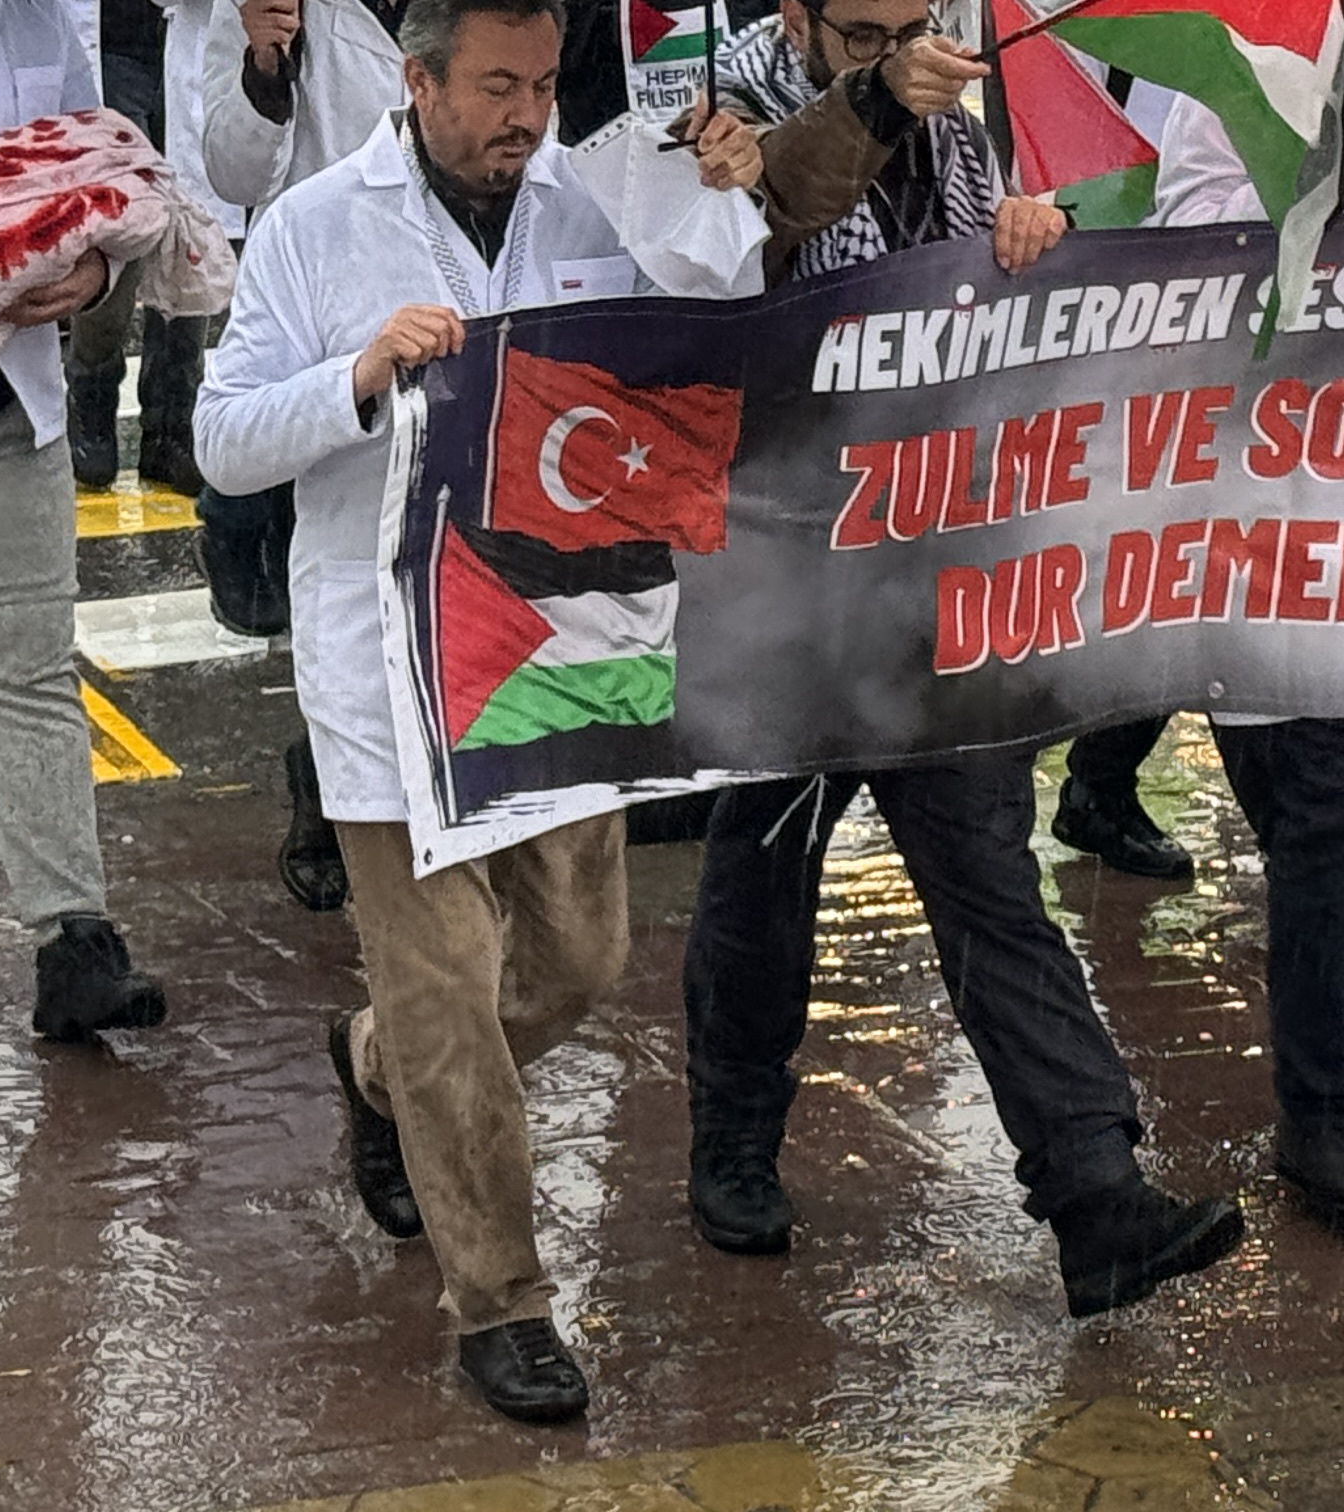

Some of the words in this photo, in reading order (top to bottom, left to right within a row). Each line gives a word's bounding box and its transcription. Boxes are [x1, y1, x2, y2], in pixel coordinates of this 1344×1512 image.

[646, 64, 705, 86] HEPİM
[812, 273, 1244, 393] HEKİMLERDEN
[830, 401, 1104, 549] ZULME
[1123, 386, 1235, 494] VE
[934, 543, 1087, 676] DUR
